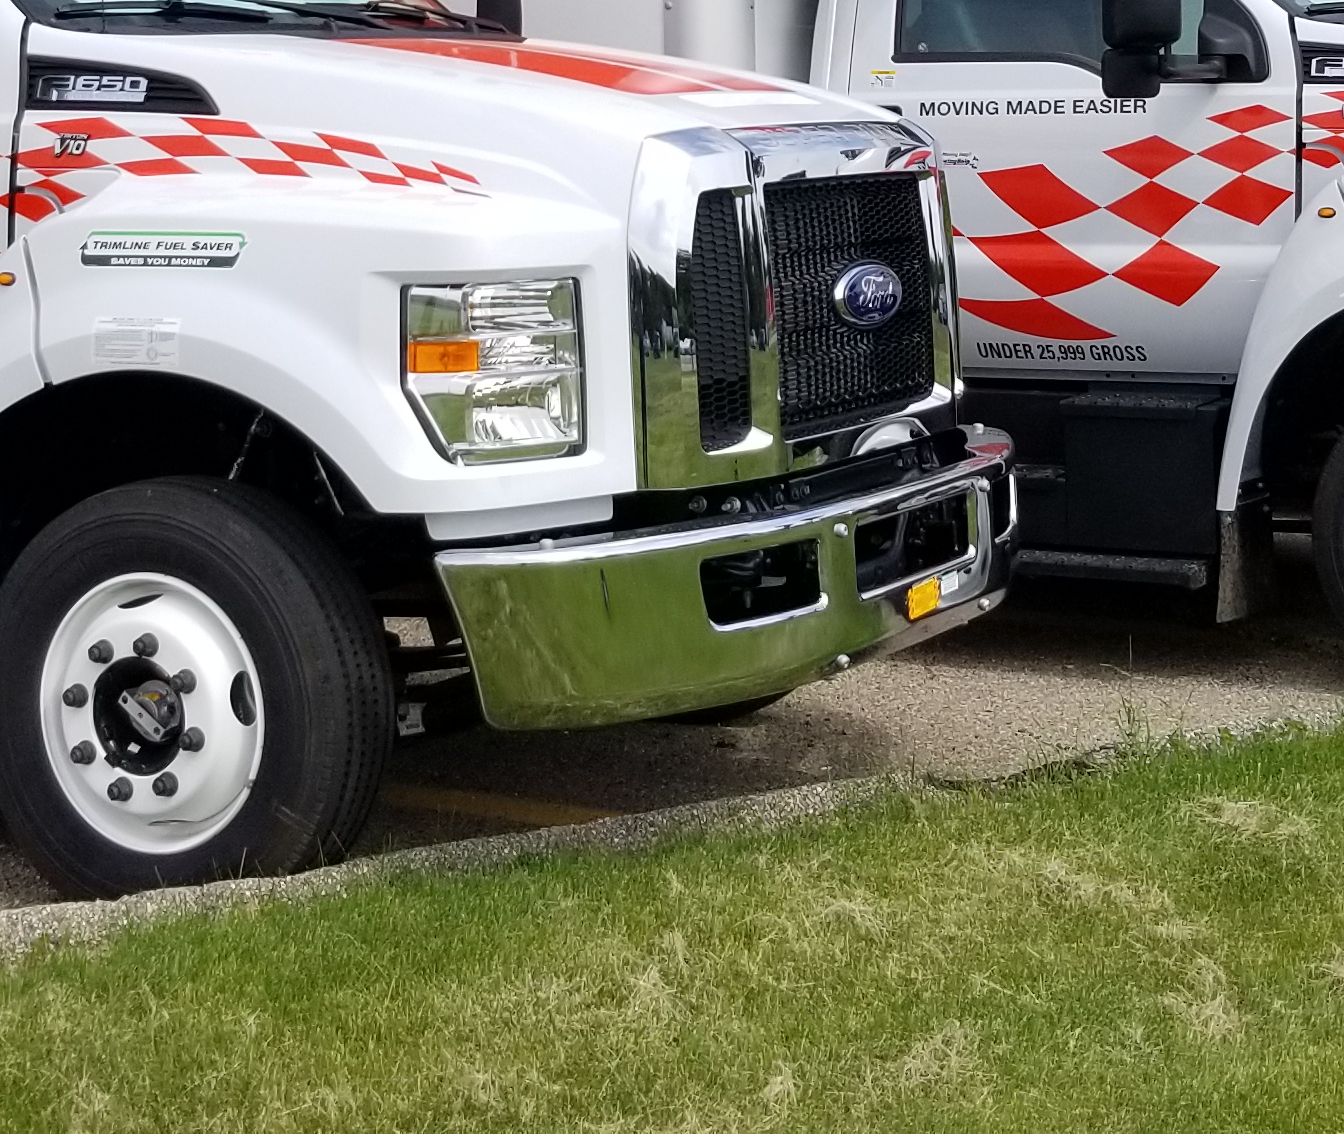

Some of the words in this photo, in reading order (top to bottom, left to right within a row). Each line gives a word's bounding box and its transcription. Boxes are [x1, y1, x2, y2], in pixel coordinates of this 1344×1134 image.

[919, 100, 1000, 118] MOVING
[1006, 99, 1067, 116] MADE
[1071, 97, 1148, 115] EASIER
[53, 137, 87, 158] V10
[859, 274, 894, 309] Ford
[976, 342, 1035, 362] UNDER
[1036, 342, 1087, 364] 25,999
[1089, 344, 1148, 364] GROSS
